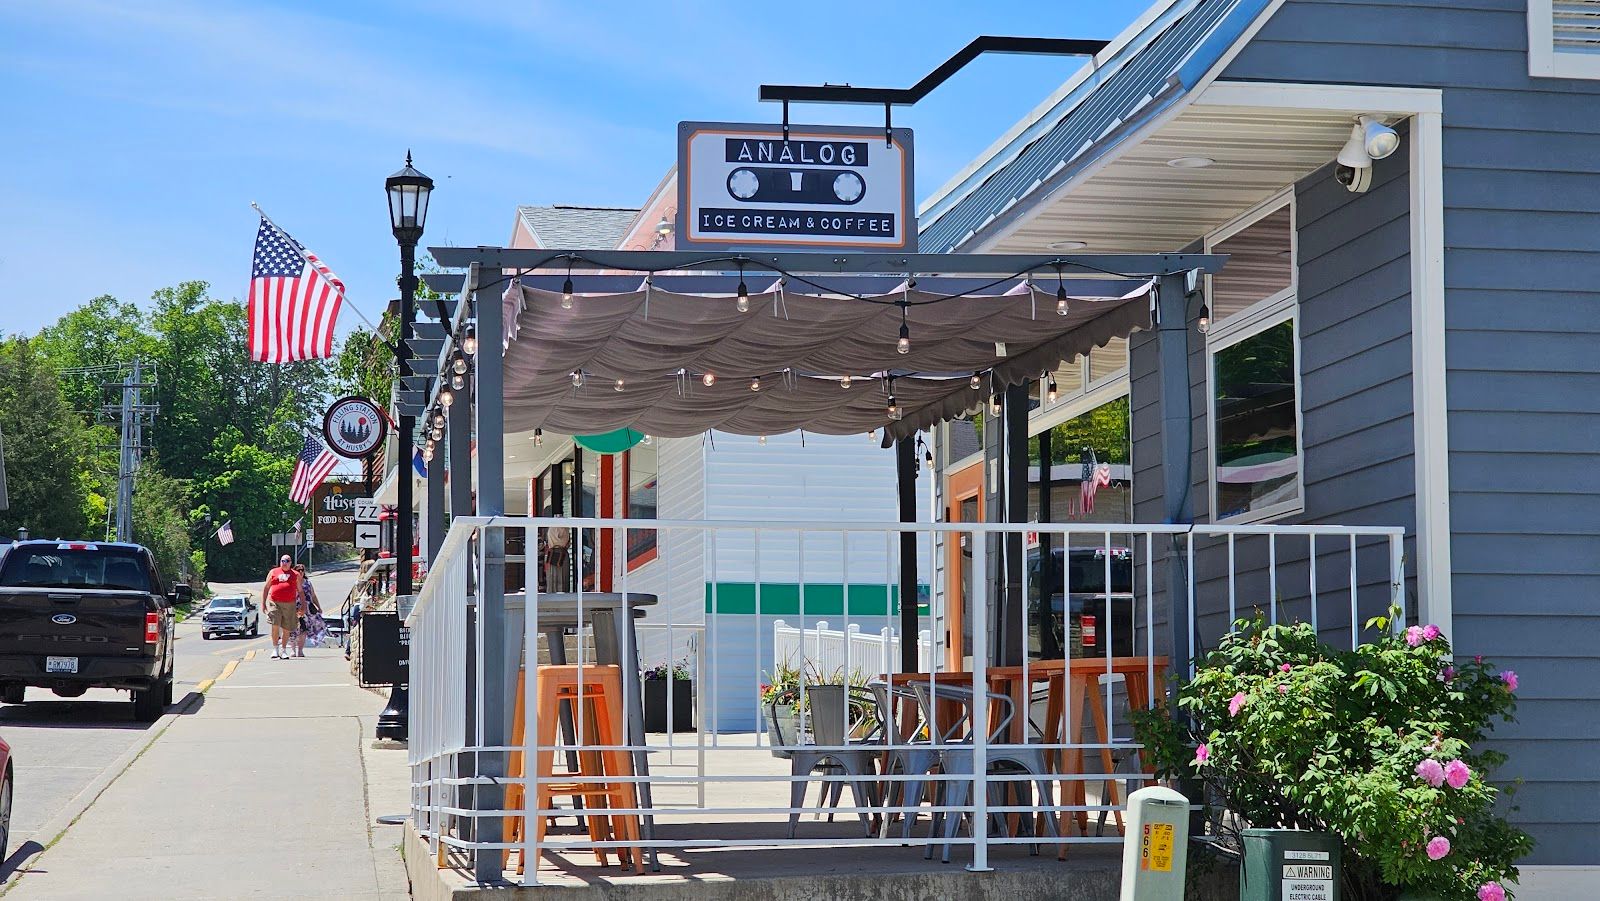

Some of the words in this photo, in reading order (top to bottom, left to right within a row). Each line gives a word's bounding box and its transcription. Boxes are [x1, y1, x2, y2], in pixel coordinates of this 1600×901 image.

[738, 142, 856, 164] ANALOG
[703, 214, 736, 228] ICE
[742, 215, 800, 229] CREAM
[806, 216, 815, 229] &
[820, 217, 891, 232] COFFEE
[332, 404, 354, 424] FILLING
[355, 404, 378, 424] STATION
[336, 438, 346, 447] AT
[346, 439, 373, 451] HUSBY'S
[358, 506, 377, 518] ZZ
[317, 515, 337, 524] FOOD
[343, 515, 355, 524] SP
[1297, 866, 1331, 879] WARNING
[1289, 893, 1311, 901] ELECTRIC
[1311, 893, 1327, 901] CABLE
